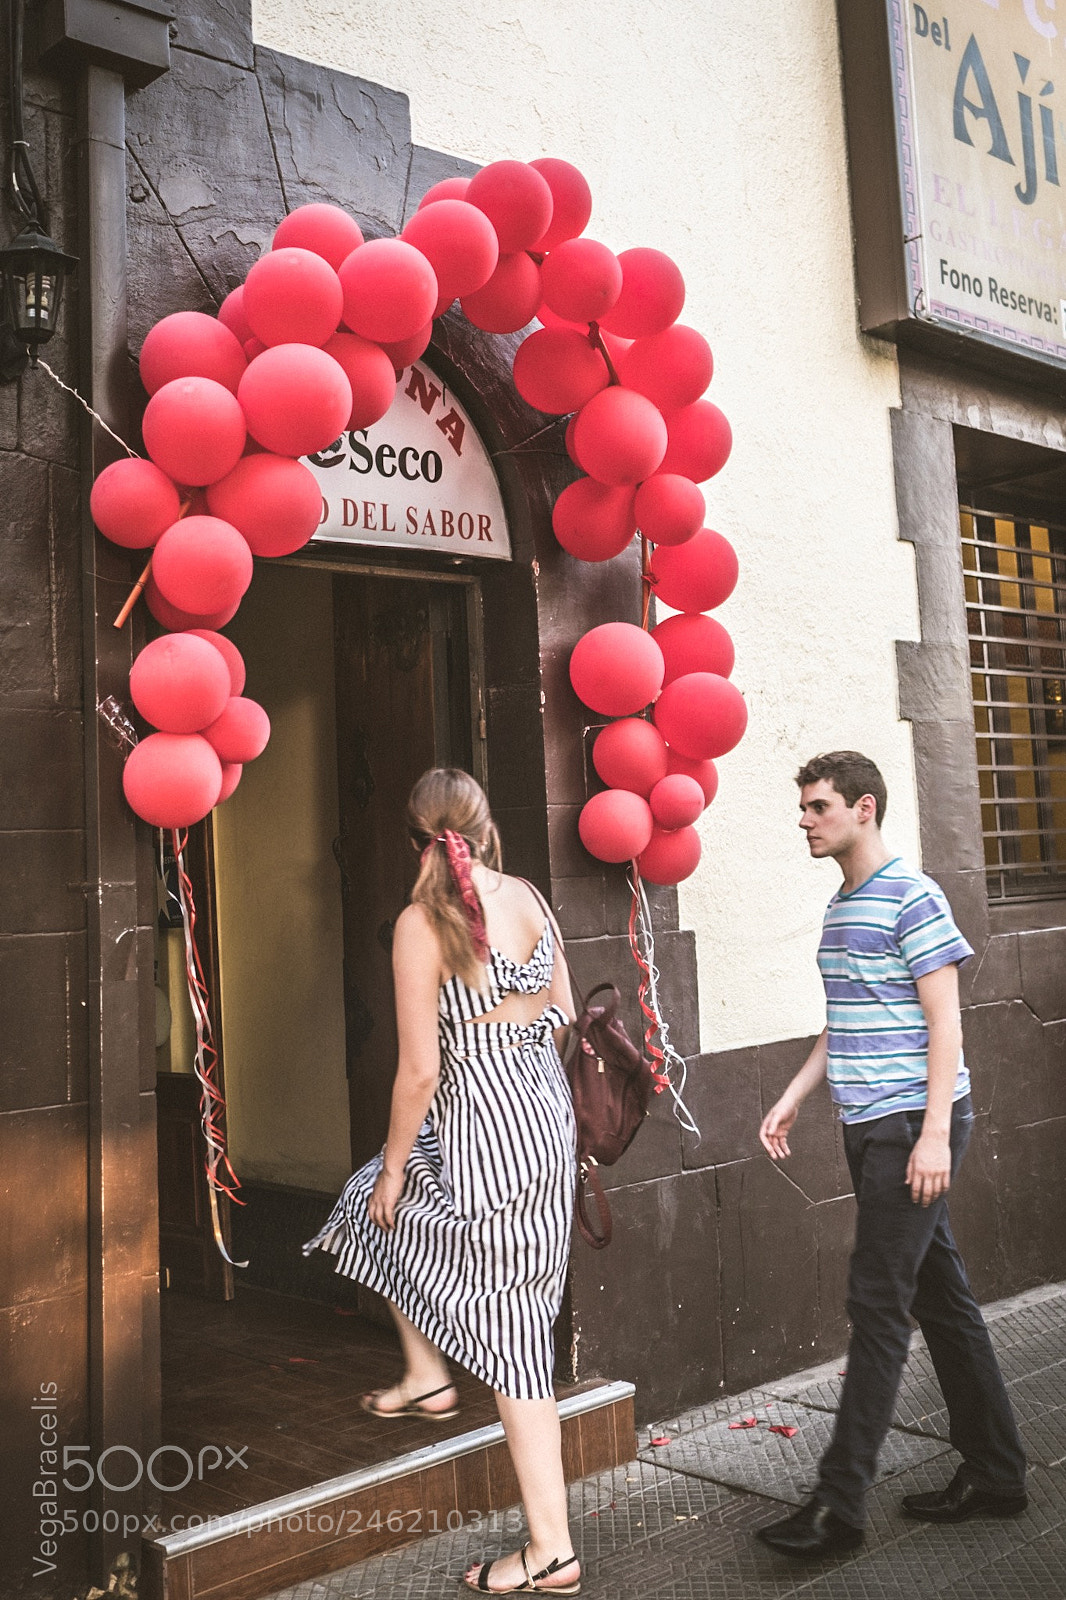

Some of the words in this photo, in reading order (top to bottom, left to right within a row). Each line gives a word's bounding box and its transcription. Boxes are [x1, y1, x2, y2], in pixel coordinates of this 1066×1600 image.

[913, 3, 951, 52] Del
[940, 258, 983, 298] Fono
[988, 276, 1058, 326] Reserva:
[341, 498, 396, 532] DEL
[405, 506, 493, 542] SABOR
